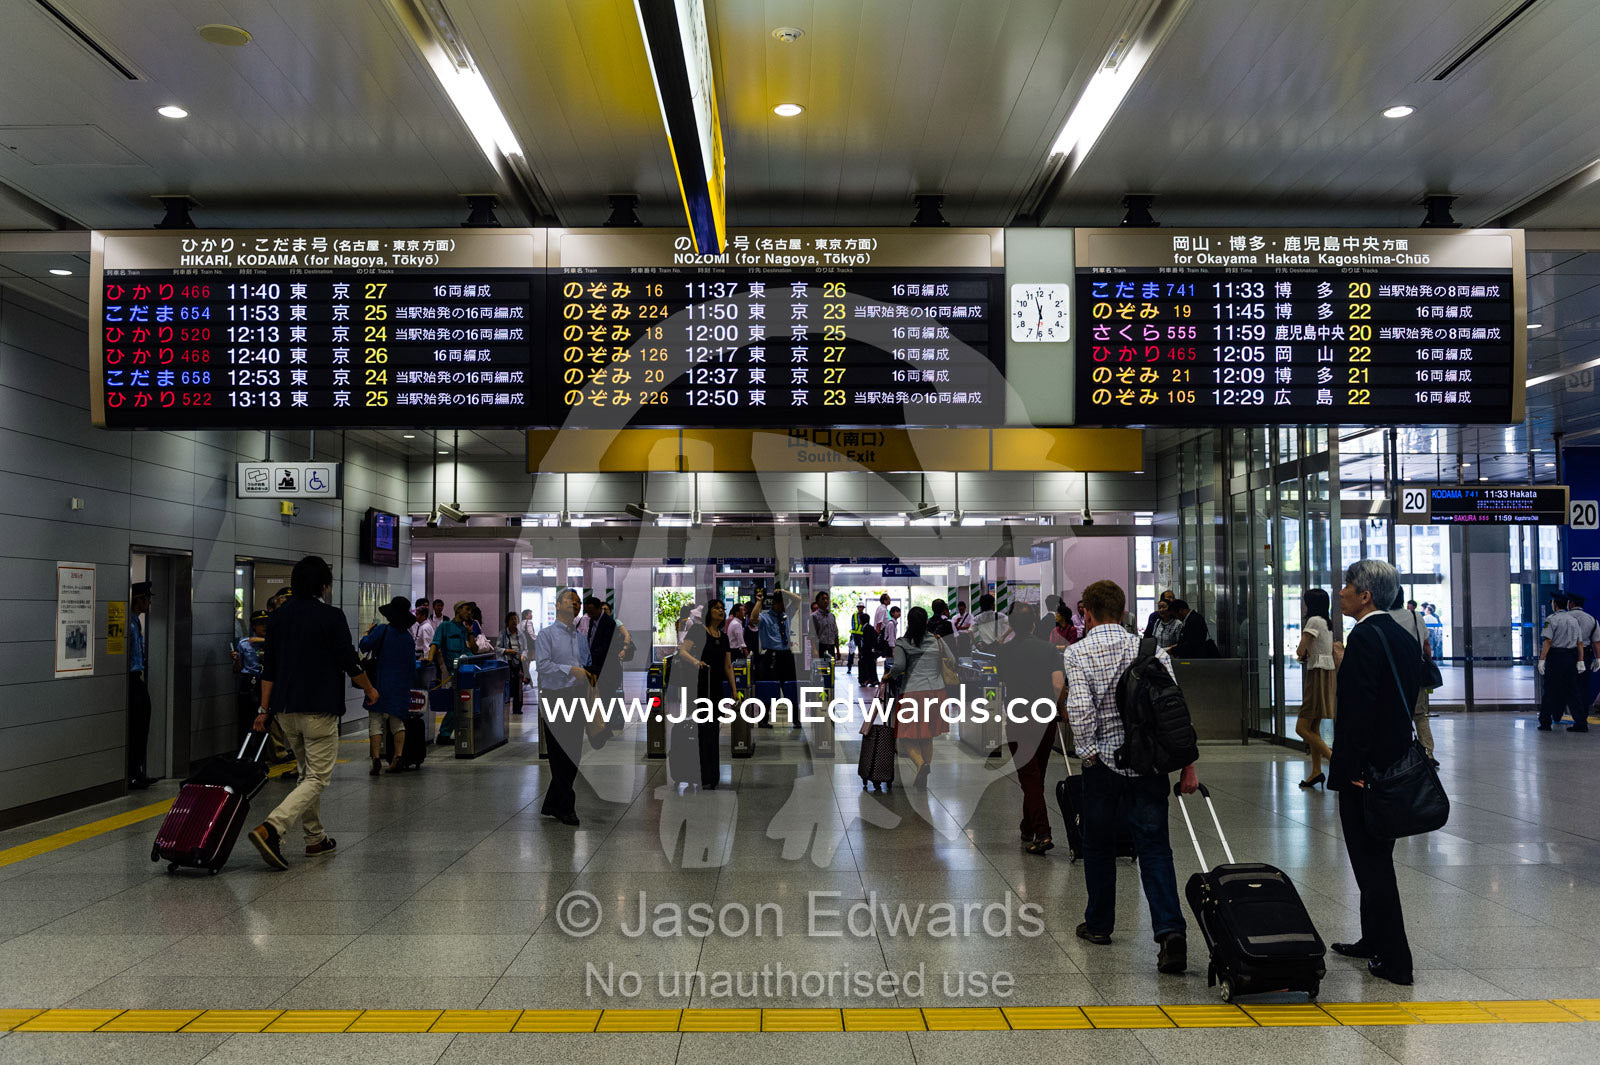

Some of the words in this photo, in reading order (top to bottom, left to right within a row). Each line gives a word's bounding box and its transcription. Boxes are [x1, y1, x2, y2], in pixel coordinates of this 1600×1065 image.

[181, 237, 328, 253] ひかり・こだま号
[180, 254, 232, 267] HIKARI,
[237, 254, 299, 266] KODAMA
[304, 254, 330, 266] (for
[333, 254, 388, 268] Nagoya,
[674, 253, 730, 264] NOZOMI
[735, 253, 760, 265] (for
[765, 253, 820, 267] Nagoya,
[1174, 254, 1192, 264] for
[1196, 253, 1258, 266] Okayama
[1265, 254, 1310, 264] Hakata
[107, 284, 173, 300] ひかり
[182, 286, 209, 298] 466
[228, 284, 280, 299] 11:40
[365, 284, 387, 299] 27
[564, 282, 631, 299] のぞみ
[646, 284, 663, 296] 16
[686, 283, 738, 298] 11:37
[824, 283, 846, 298] 26
[1036, 290, 1044, 298] 12
[1092, 281, 1159, 299] こだま
[1167, 284, 1194, 296] 741
[1213, 282, 1264, 298] 11:33
[1349, 283, 1371, 298] 20
[106, 305, 173, 322] こだま
[181, 307, 210, 320] 654
[227, 305, 280, 321] 11:53
[365, 305, 387, 320] 25
[564, 303, 631, 320] のぞみ
[639, 305, 668, 318] 224
[686, 304, 738, 320] 11:50
[824, 304, 846, 319] 23
[1093, 303, 1159, 319] のぞみ
[1174, 305, 1191, 317] 19
[1213, 304, 1265, 319] 11:45
[1349, 304, 1371, 319] 22
[106, 327, 173, 343] ひかり
[181, 328, 210, 341] 520
[227, 327, 279, 342] 12:13
[365, 326, 387, 341] 24
[564, 325, 631, 342] のぞみ
[646, 327, 663, 340] 18
[685, 325, 738, 341] 12:00
[824, 325, 846, 341] 25
[1093, 324, 1160, 341] さくら
[1168, 326, 1196, 339] 555
[1213, 325, 1265, 340] 11:59
[1275, 324, 1344, 340] 鹿児島中央
[1349, 325, 1371, 341] 20
[107, 348, 173, 364] ひかり
[182, 350, 209, 362] 468
[228, 348, 280, 364] 12:40
[365, 348, 387, 363] 26
[564, 346, 631, 363] のぞみ
[640, 348, 668, 361] 126
[685, 347, 738, 362] 12:17
[824, 347, 846, 362] 27
[1093, 346, 1159, 362] ひかり
[1168, 348, 1196, 360] 465
[1213, 346, 1265, 362] 12:05
[1349, 346, 1371, 362] 22
[107, 369, 174, 387] こだま
[182, 371, 210, 384] 658
[228, 370, 280, 385] 12:53
[366, 370, 387, 385] 24
[564, 368, 632, 385] のぞみ
[645, 369, 664, 383] 20
[686, 368, 738, 384] 12:37
[824, 368, 846, 383] 27
[1093, 367, 1159, 384] のぞみ
[1173, 369, 1189, 382] 21
[1213, 368, 1265, 383] 12:09
[1349, 368, 1368, 383] 21
[108, 391, 175, 407] ひかり
[183, 393, 211, 405] 522
[229, 391, 280, 407] 13:13
[366, 391, 388, 406] 25
[565, 389, 632, 406] のぞみ
[640, 391, 668, 404] 226
[686, 390, 738, 405] 12:50
[824, 390, 846, 405] 23
[1092, 389, 1159, 405] のぞみ
[1168, 391, 1195, 403] 105
[1212, 389, 1264, 405] 12:29
[1348, 389, 1370, 404] 22
[797, 450, 841, 463] South
[846, 450, 875, 463] Exit
[1405, 492, 1425, 510] 20
[1432, 490, 1462, 499] KODAMA
[1484, 490, 1509, 499] 11:33
[1510, 490, 1537, 498] Hakata
[1453, 514, 1477, 522] SAKURA
[1494, 514, 1513, 522] 11:59
[1572, 504, 1597, 526] 20
